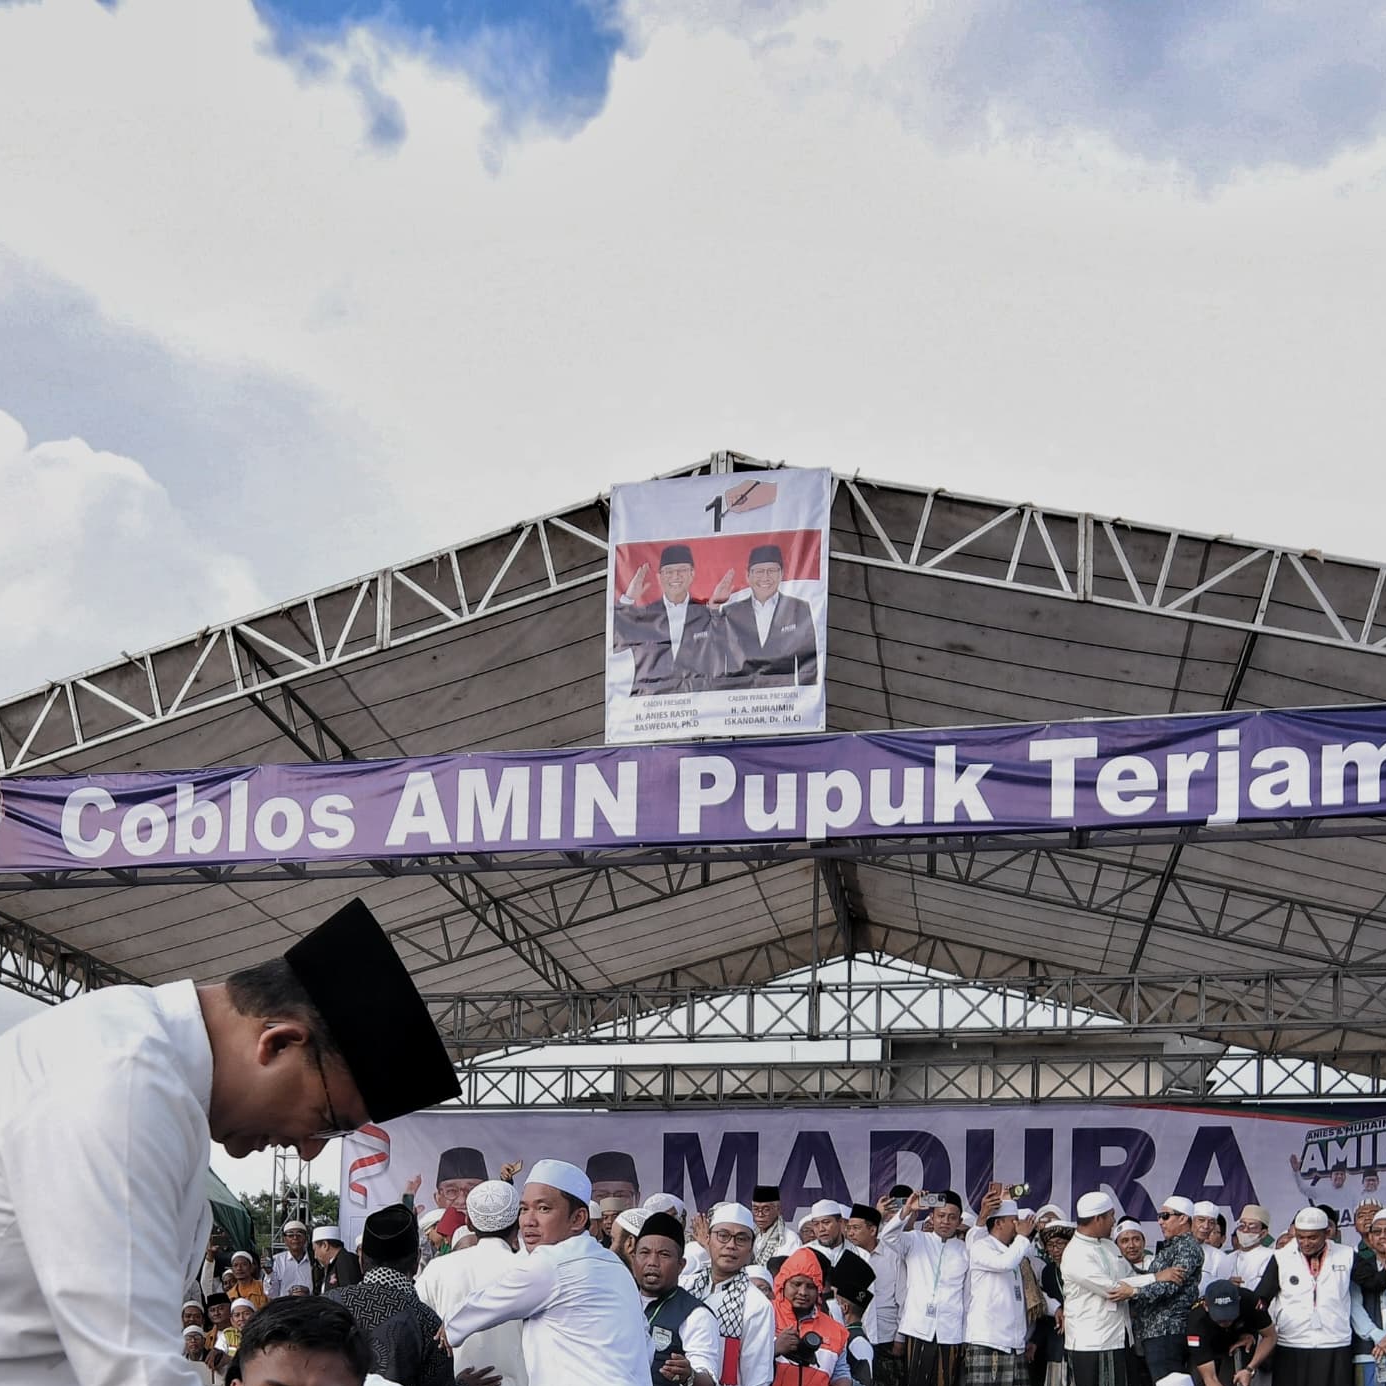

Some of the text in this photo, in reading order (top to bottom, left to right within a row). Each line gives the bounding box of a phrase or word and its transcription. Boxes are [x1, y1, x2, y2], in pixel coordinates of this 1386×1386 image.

[705, 495, 724, 532] 1
[645, 711, 668, 721] ANIES
[670, 708, 699, 718] RASYID
[731, 703, 795, 715] H. A. MUHAIMIN
[60, 781, 357, 859] Coblos
[385, 760, 638, 848] AMIN
[677, 745, 995, 841] Pupuk
[1306, 1129, 1336, 1141] ANIES
[663, 1125, 1261, 1222] MADURA
